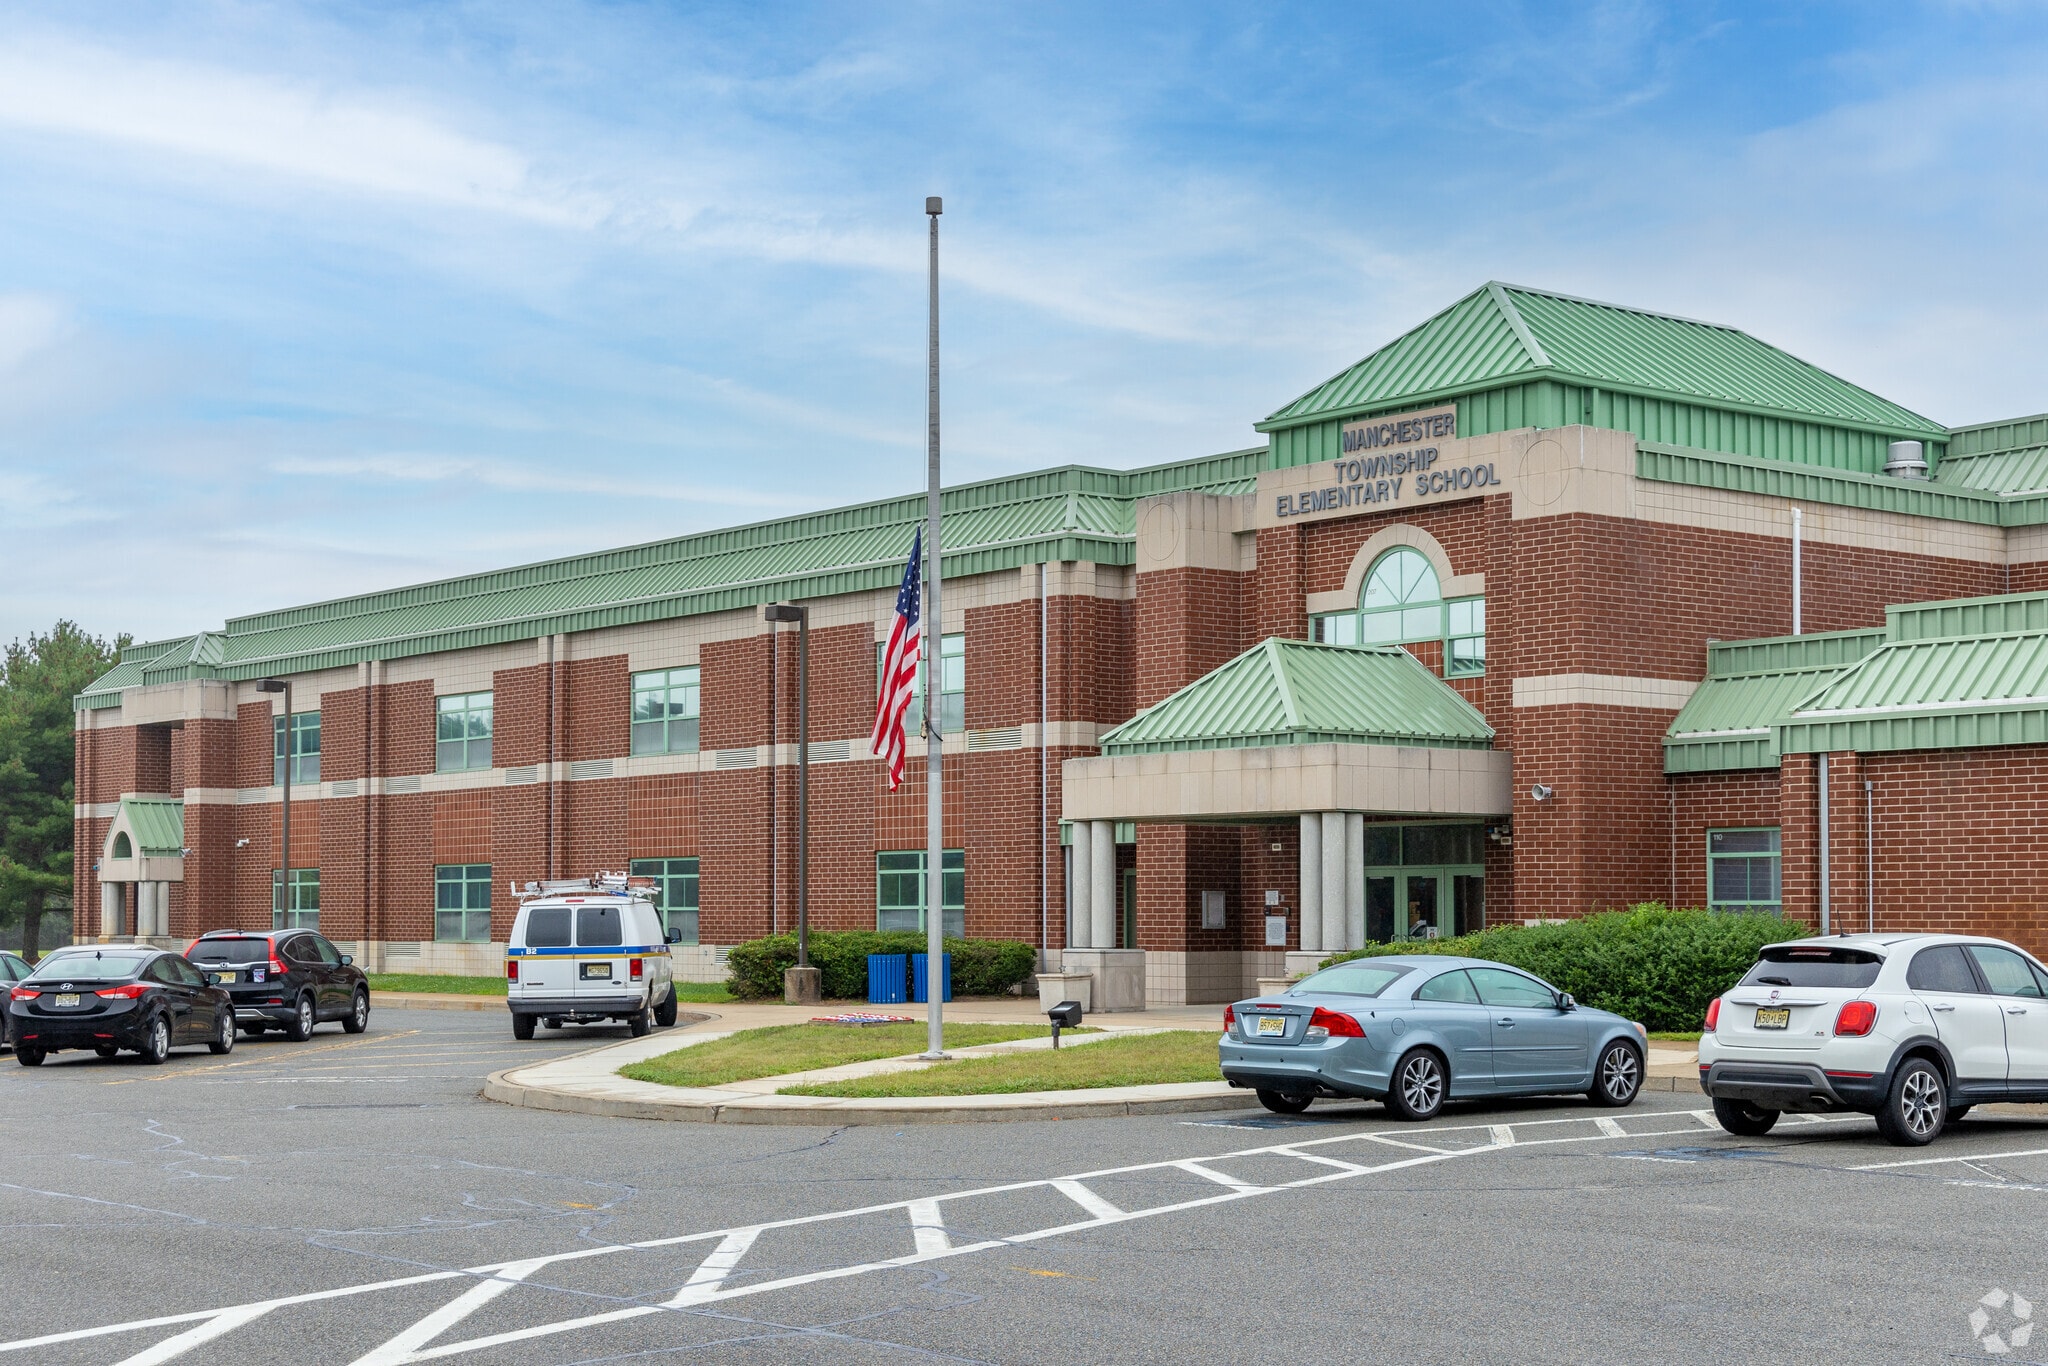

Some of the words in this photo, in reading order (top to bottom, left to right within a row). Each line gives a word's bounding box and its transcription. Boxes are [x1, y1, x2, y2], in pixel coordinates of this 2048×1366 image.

[1343, 413, 1455, 453] MANCHESTER
[1334, 447, 1438, 483] TOWNSHIP
[1277, 477, 1402, 517] ELEMENTARY
[1415, 463, 1500, 496] SCHOOL
